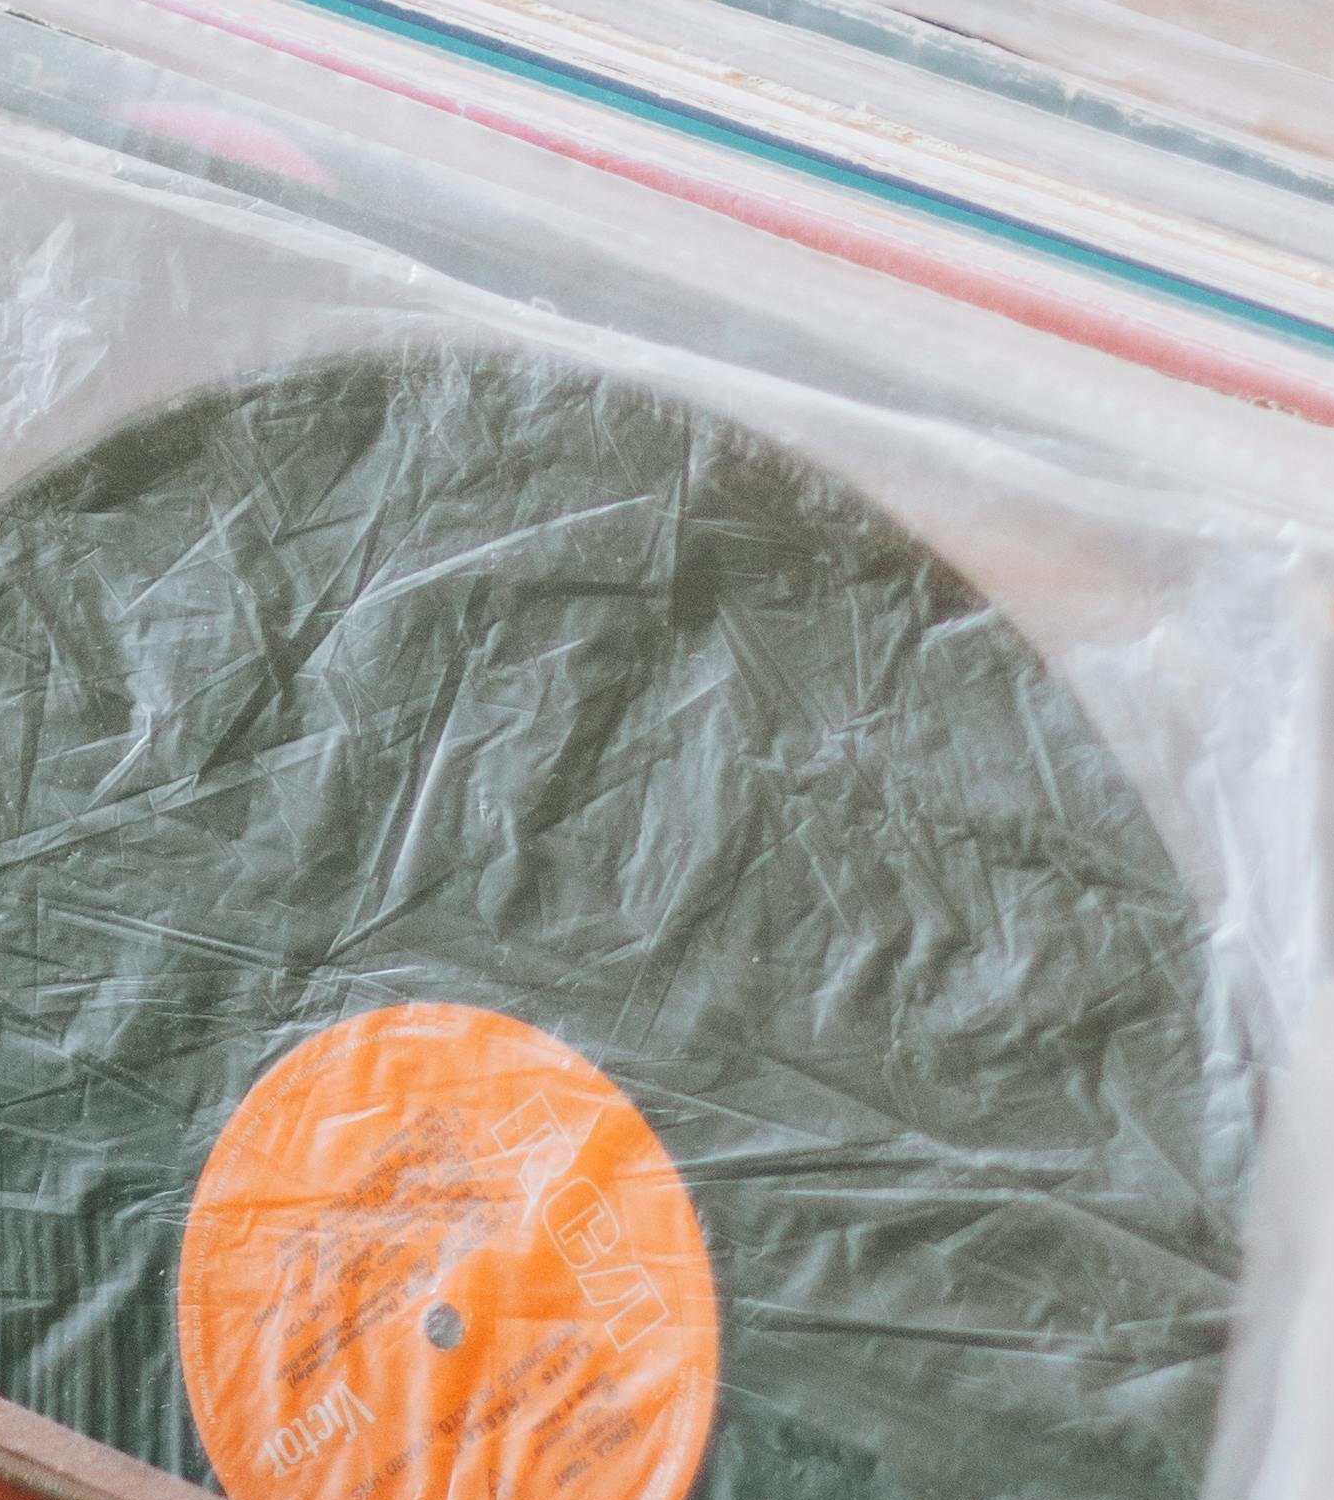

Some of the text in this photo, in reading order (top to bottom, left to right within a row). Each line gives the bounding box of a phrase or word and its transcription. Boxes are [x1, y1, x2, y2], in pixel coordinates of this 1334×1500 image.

[491, 1091, 669, 1353] RCA
[537, 1337, 595, 1386] ELVIS
[261, 1380, 376, 1481] Victor
